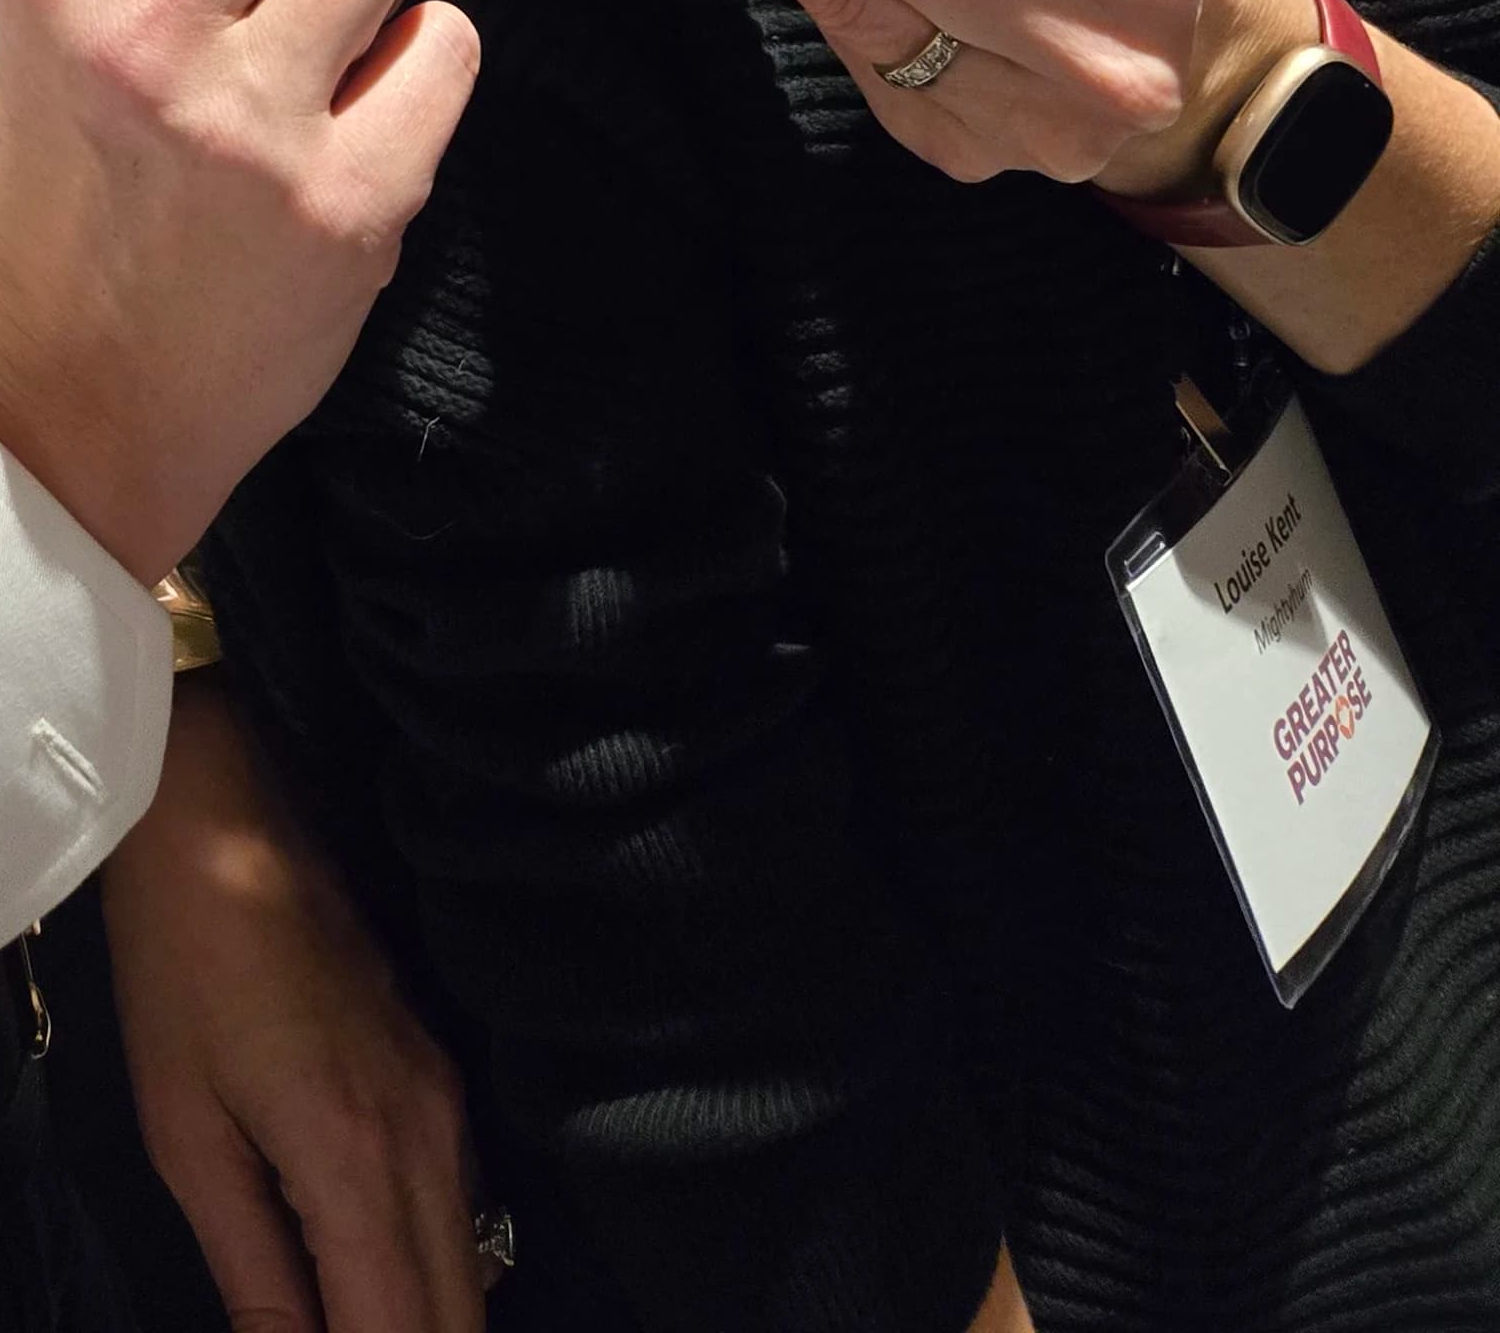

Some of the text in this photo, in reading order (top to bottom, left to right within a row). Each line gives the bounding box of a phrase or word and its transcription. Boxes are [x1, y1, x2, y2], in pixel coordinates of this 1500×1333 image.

[1214, 492, 1302, 614] Louise Kent
[1273, 629, 1357, 761] GREATER
[1287, 666, 1373, 806] PURPOSE
